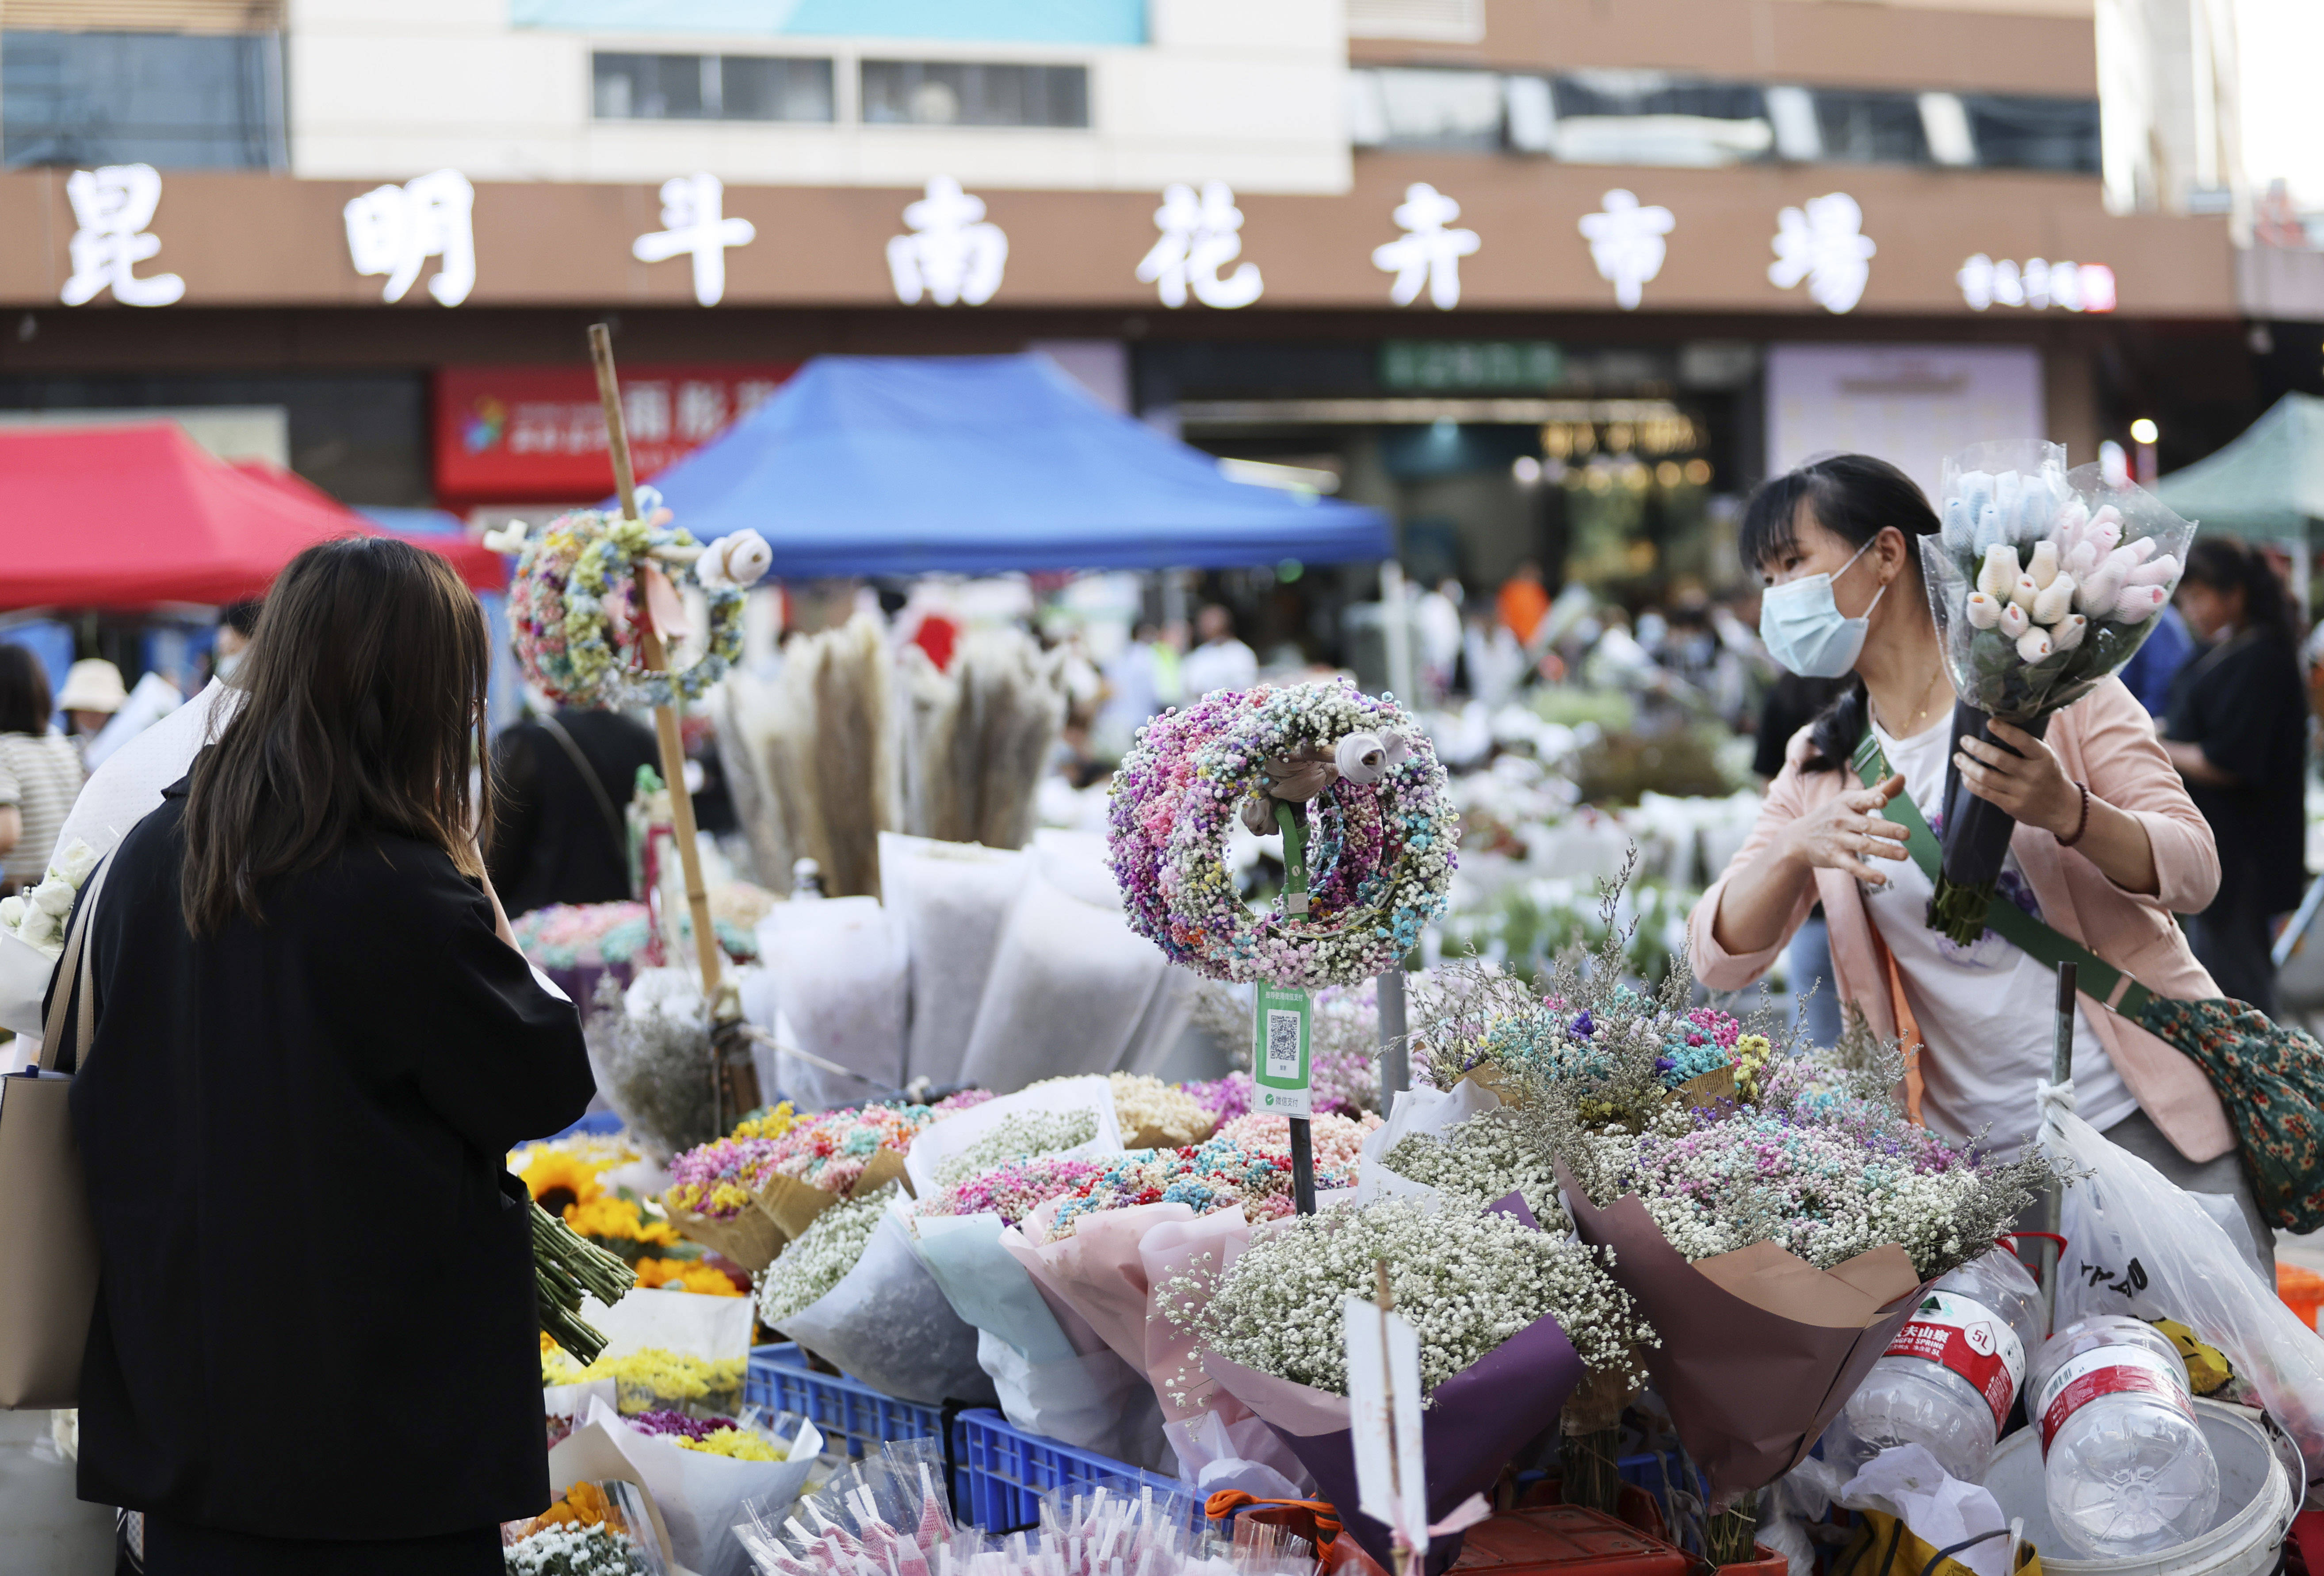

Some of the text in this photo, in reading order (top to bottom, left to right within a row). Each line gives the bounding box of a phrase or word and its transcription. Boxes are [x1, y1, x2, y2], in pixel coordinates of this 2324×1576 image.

[1265, 991, 1303, 1002] 推荐使用微信支付
[1276, 1096, 1298, 1107] 微信支付
[1915, 1338, 1944, 1350] SPRING
[1972, 1329, 1988, 1350] 5L
[1931, 1348, 1940, 1357] 5L
